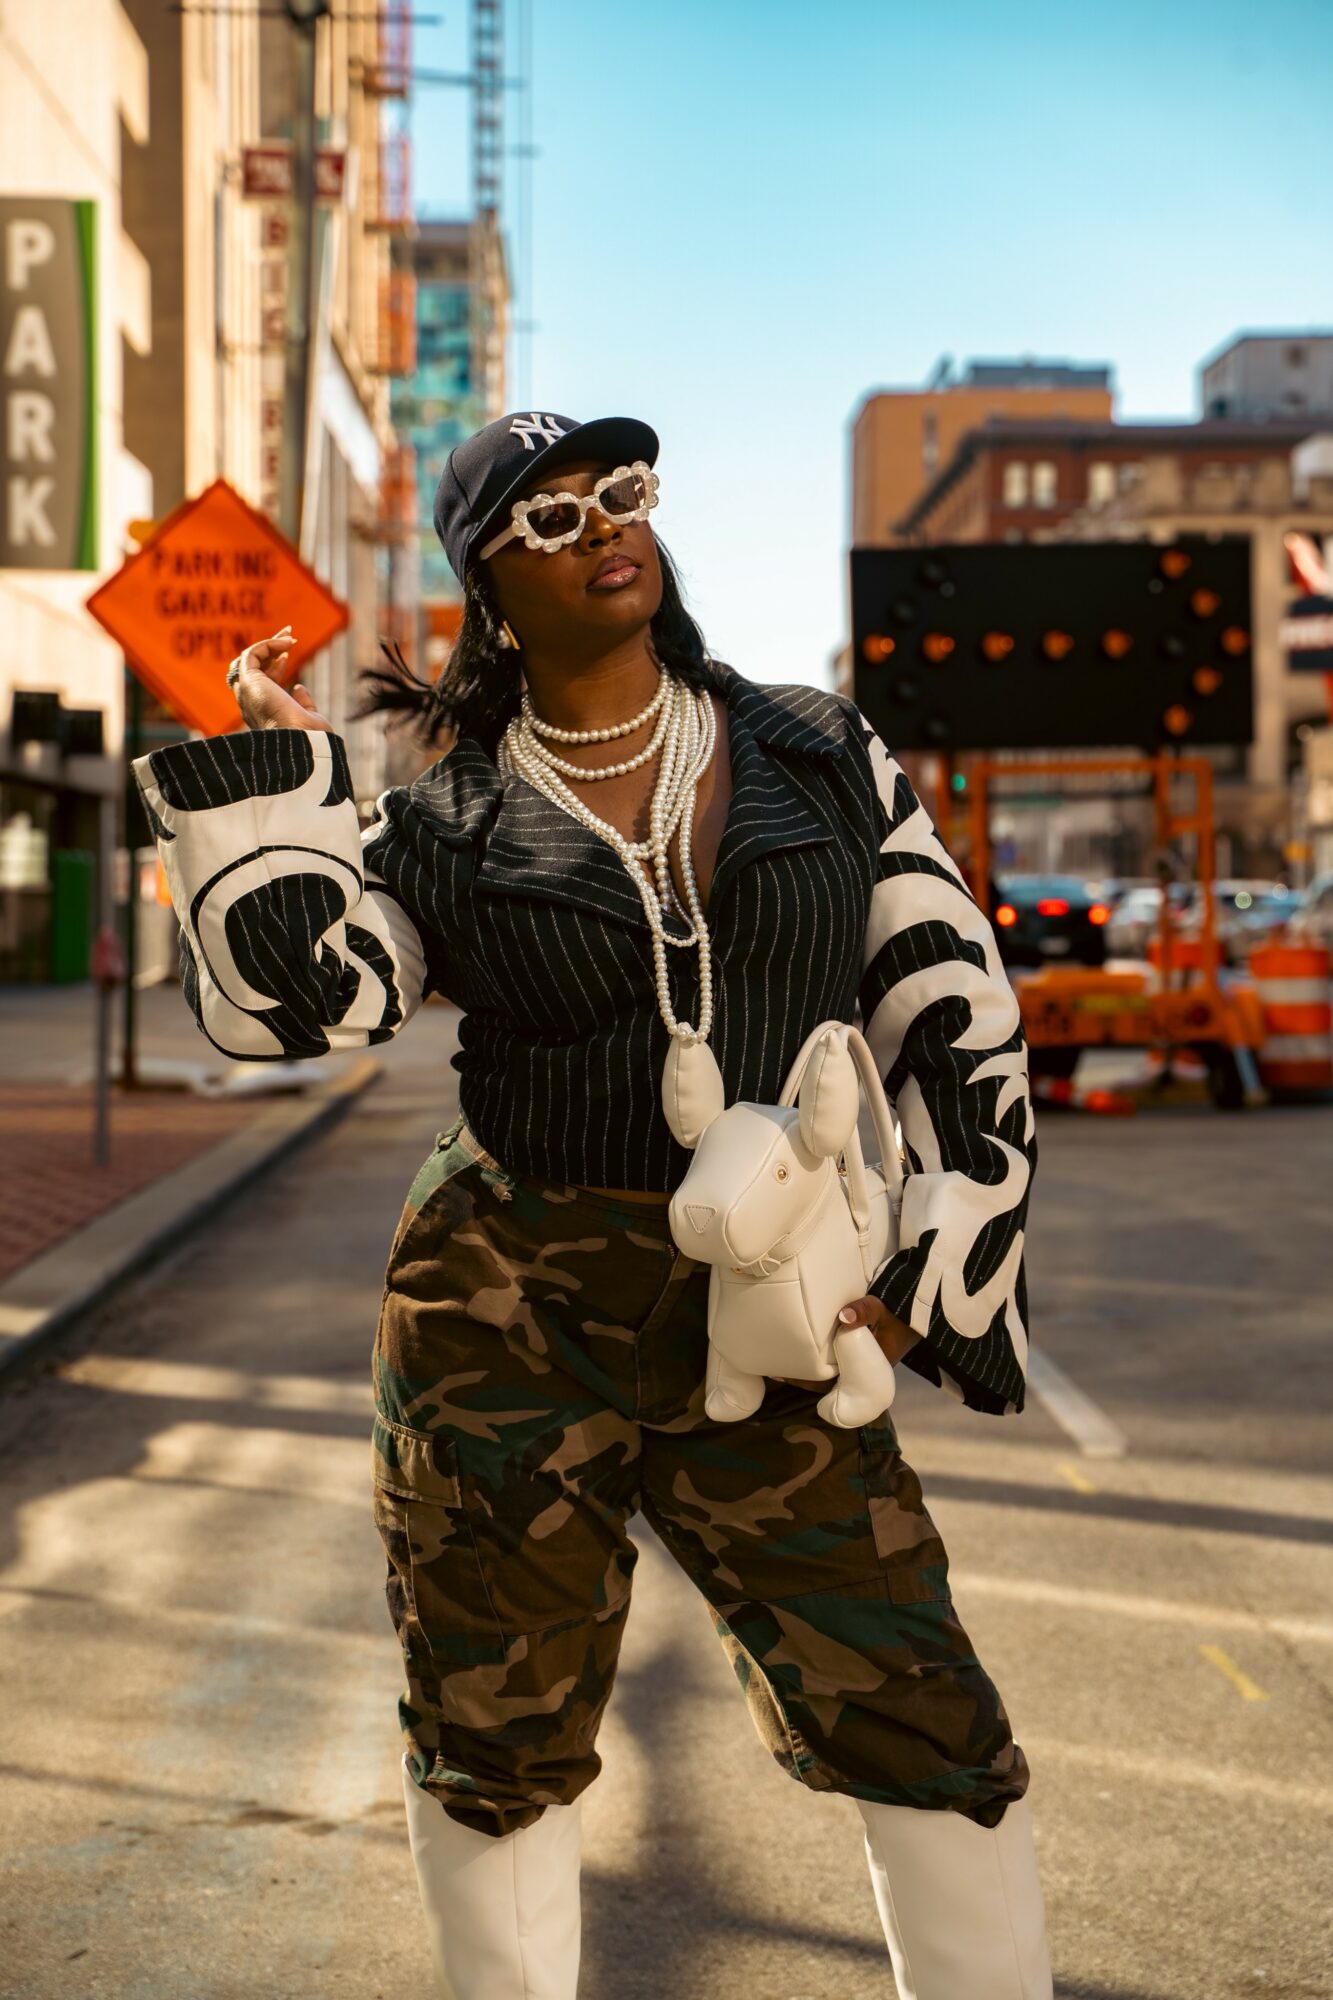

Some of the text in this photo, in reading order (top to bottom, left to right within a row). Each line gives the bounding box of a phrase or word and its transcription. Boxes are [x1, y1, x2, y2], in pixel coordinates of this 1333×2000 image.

[6, 217, 57, 546] PARK
[509, 412, 569, 451] NY
[153, 548, 275, 579] PARKING
[157, 586, 269, 620] GARAGE
